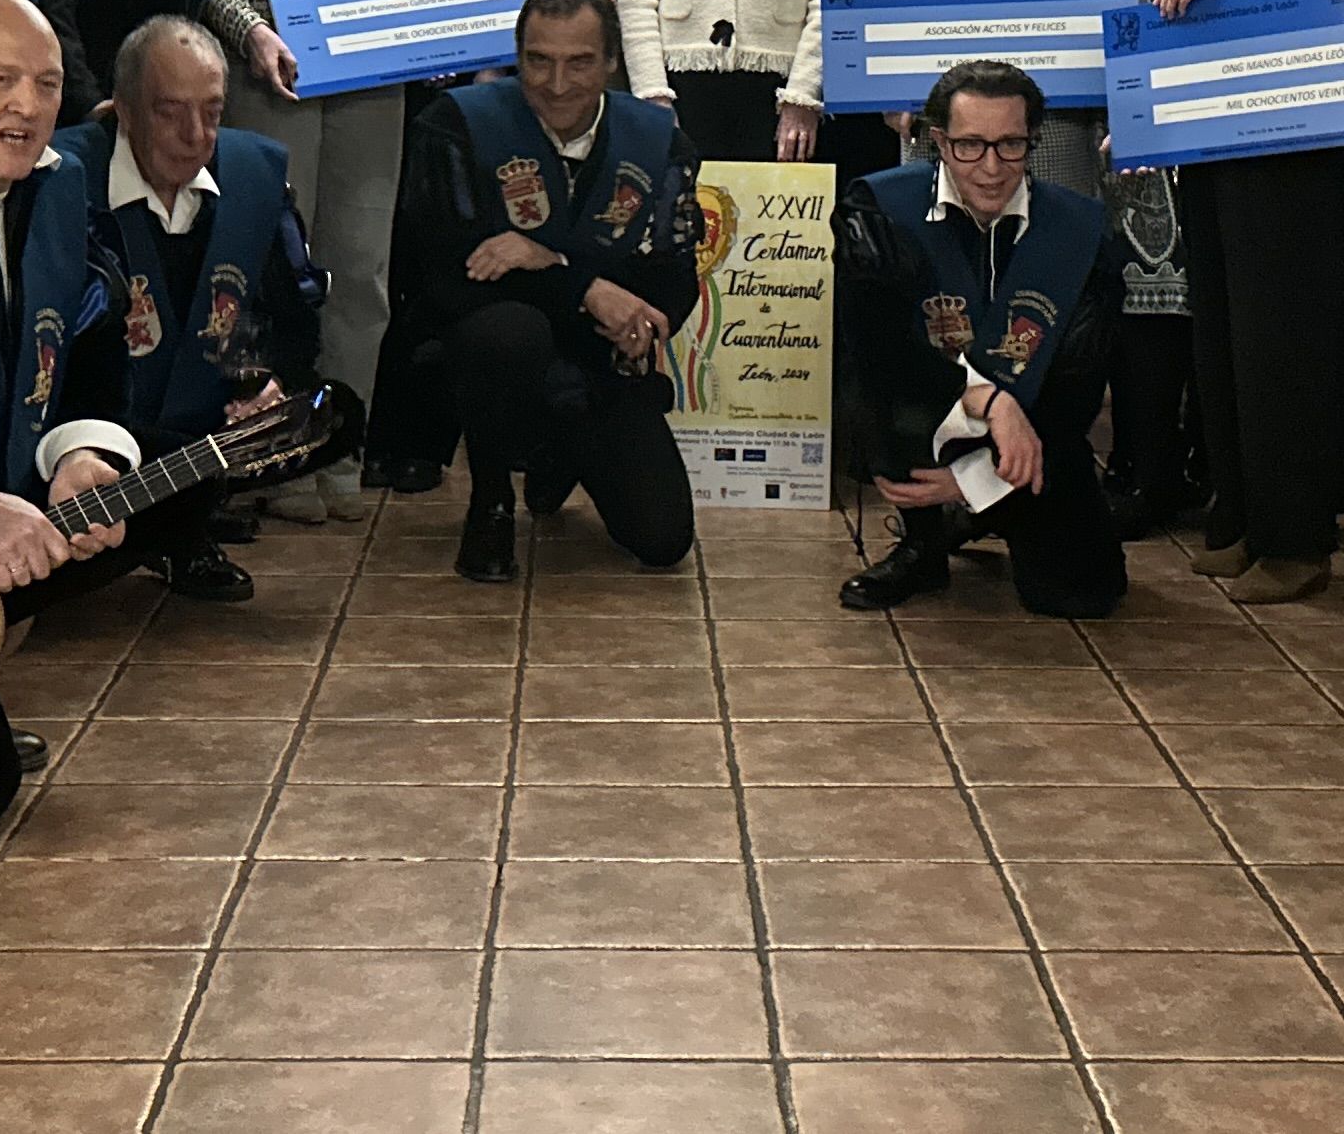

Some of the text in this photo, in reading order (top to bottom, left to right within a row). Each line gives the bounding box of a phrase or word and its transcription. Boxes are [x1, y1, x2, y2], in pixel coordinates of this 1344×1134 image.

[330, 6, 357, 19] Amigos
[358, 5, 369, 15] del
[411, 23, 468, 39] OCHOCIENTOS
[469, 18, 497, 30] VEINTE
[925, 21, 1067, 36] ASOCIACIÓN ACTIVOS Y FELICES
[1024, 55, 1057, 65] VEINTE
[1222, 62, 1245, 74] ONG
[1246, 56, 1284, 71] MANOS
[1285, 51, 1323, 65] UNIDAS
[1226, 100, 1243, 110] MIL
[1246, 89, 1316, 108] OCHOCIENTOS
[757, 194, 825, 221] XXVII
[742, 229, 828, 262] Certamen
[721, 268, 827, 301] Internacional
[759, 302, 772, 314] de
[720, 319, 823, 349] Cuarentunas
[713, 428, 755, 437] Auditorio
[756, 429, 788, 438] Ciudad
[789, 430, 801, 438] de
[802, 430, 825, 439] León
